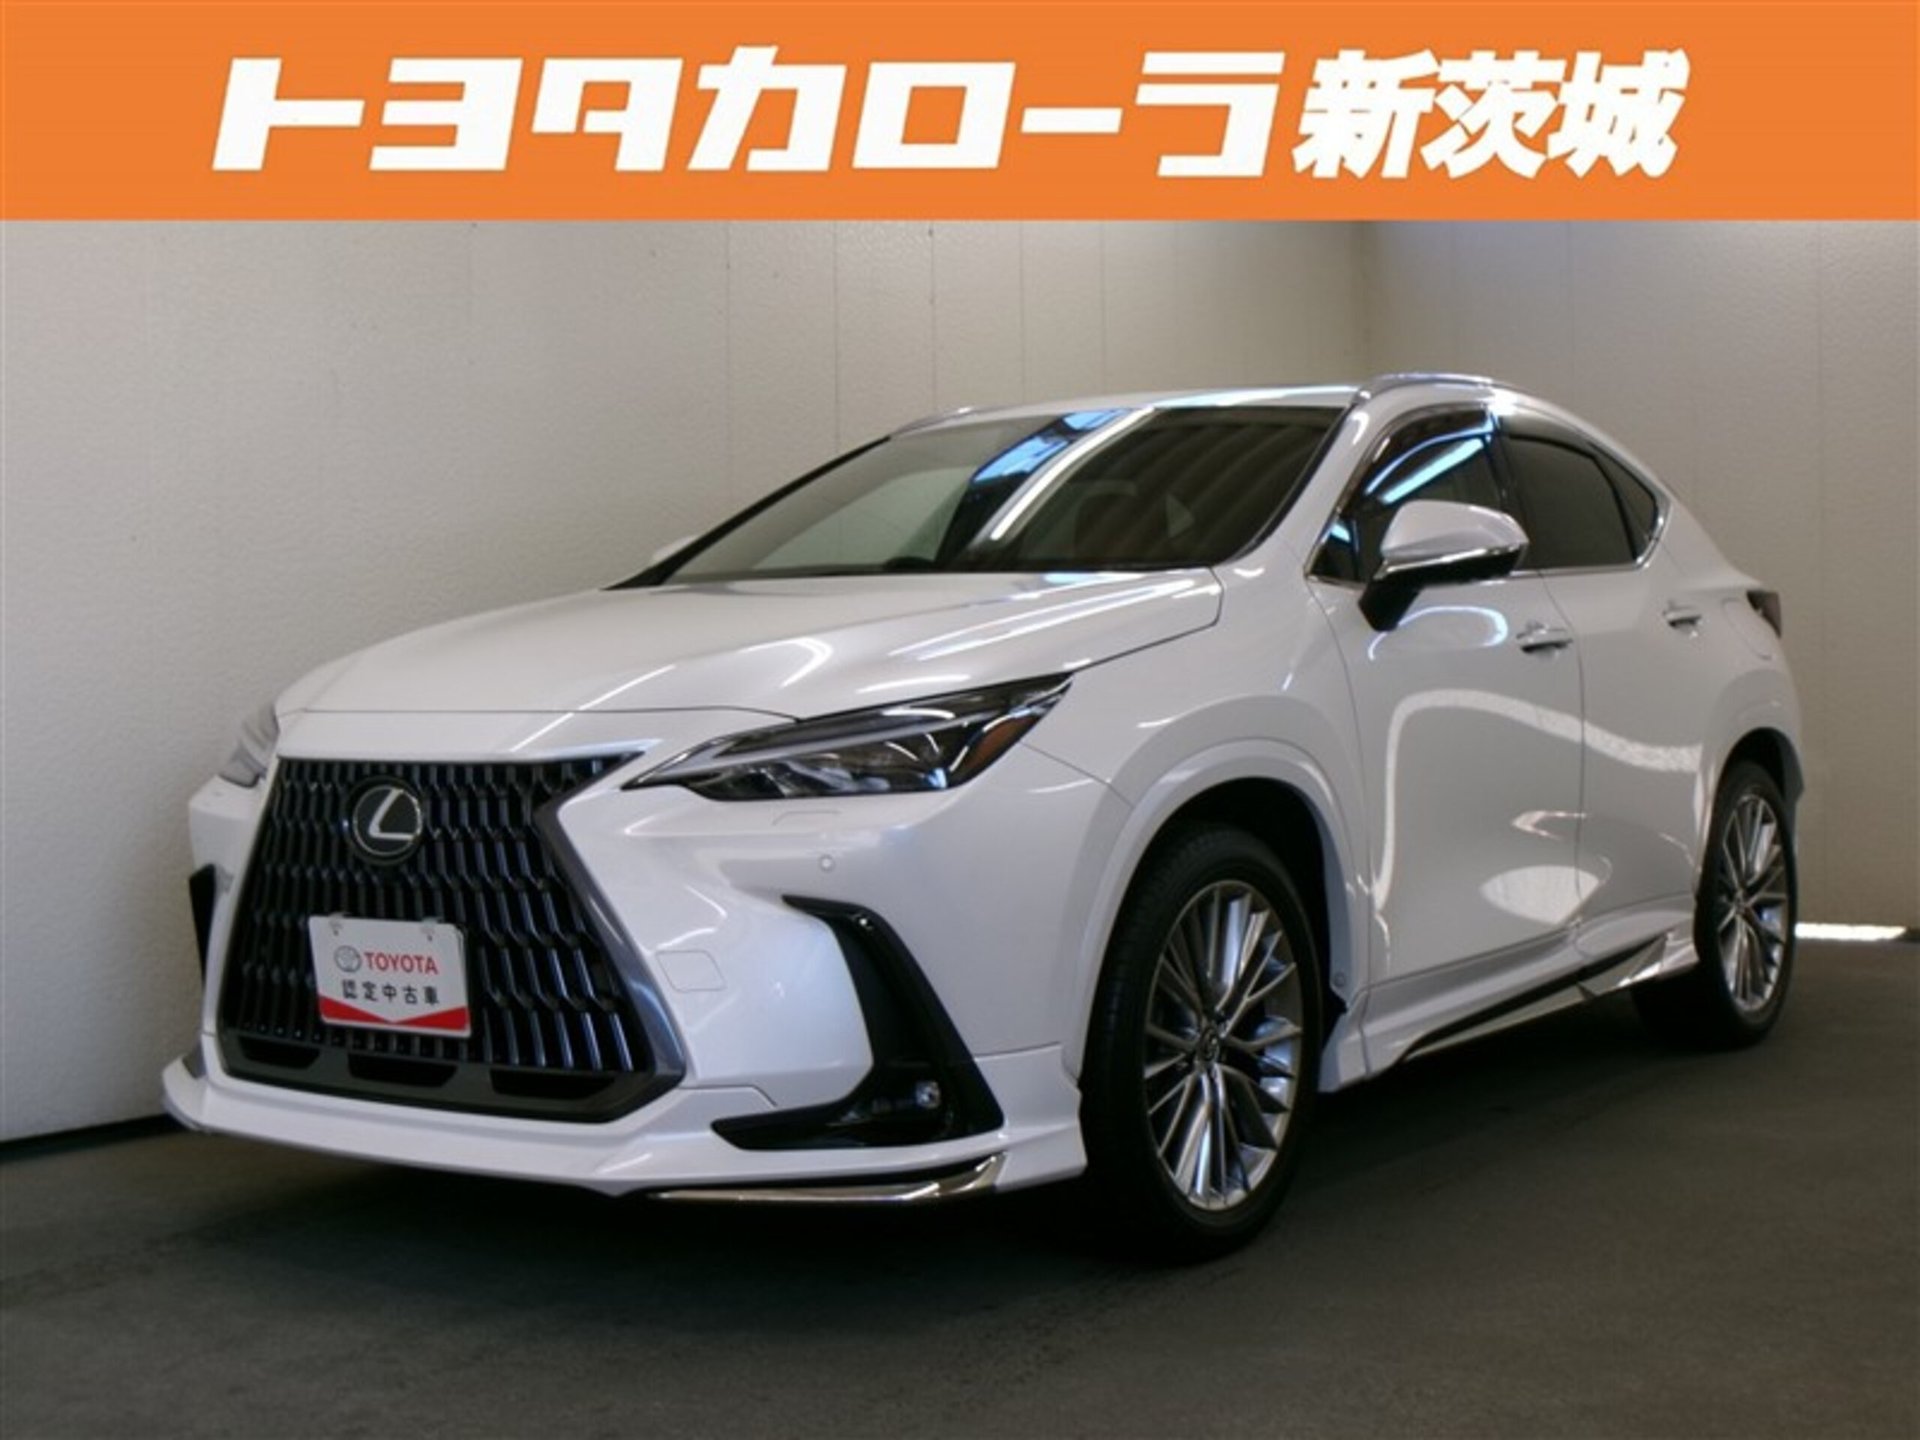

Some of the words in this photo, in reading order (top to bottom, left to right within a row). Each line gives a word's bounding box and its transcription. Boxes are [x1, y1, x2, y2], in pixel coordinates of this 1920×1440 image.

[363, 951, 439, 975] TOYOTA
[342, 979, 440, 1005] 認定中古車
